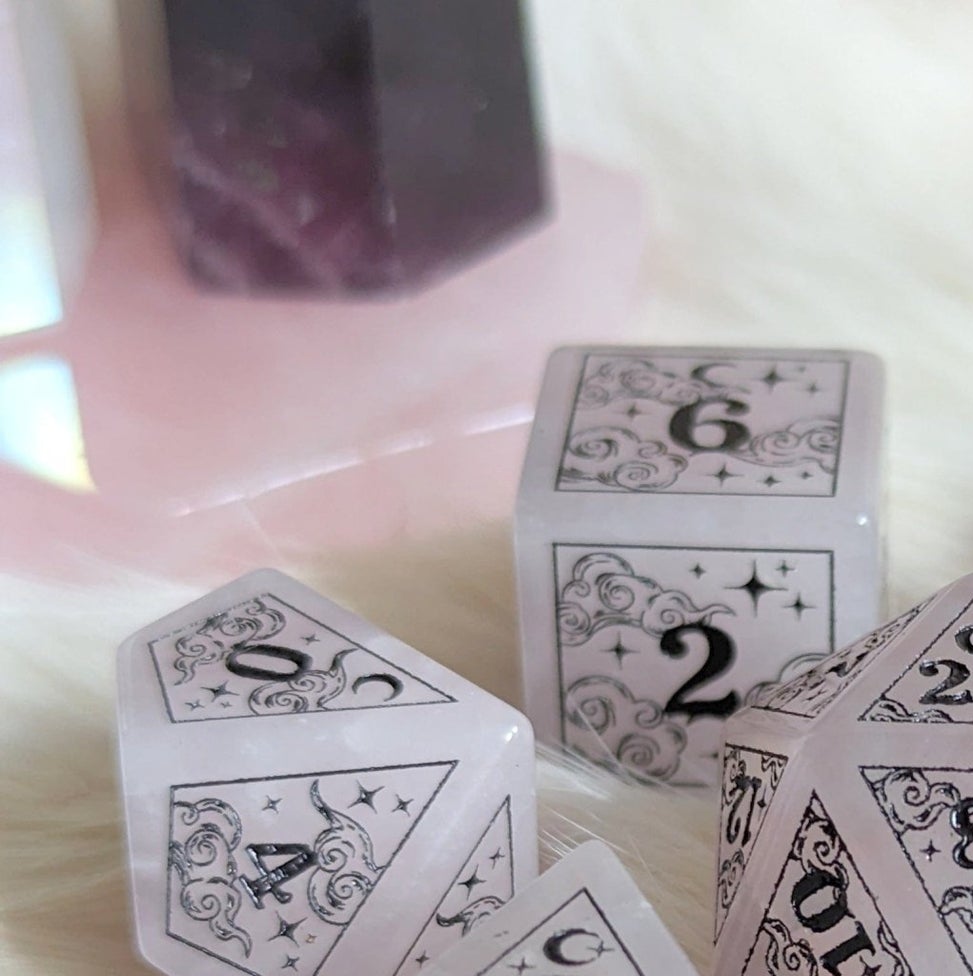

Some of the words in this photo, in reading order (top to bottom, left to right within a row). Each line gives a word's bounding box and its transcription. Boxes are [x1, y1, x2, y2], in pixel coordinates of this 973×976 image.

[667, 398, 751, 454] 6
[226, 643, 313, 681] 0
[660, 624, 741, 717] 2
[238, 843, 319, 909] 4
